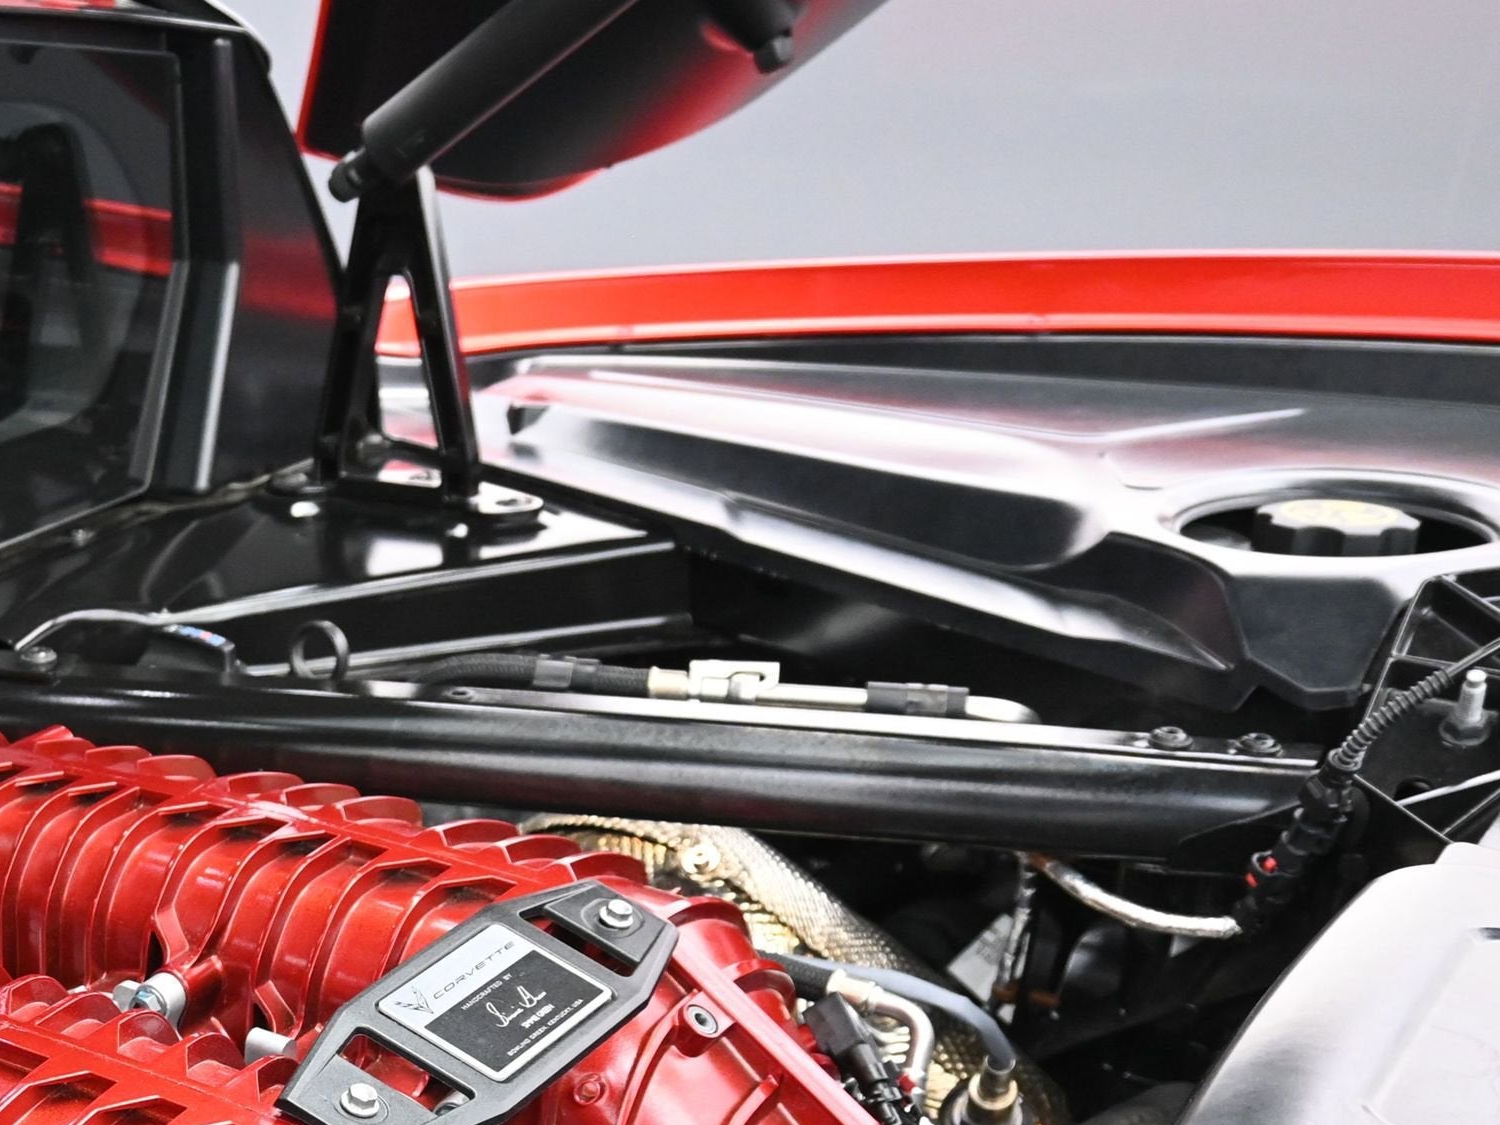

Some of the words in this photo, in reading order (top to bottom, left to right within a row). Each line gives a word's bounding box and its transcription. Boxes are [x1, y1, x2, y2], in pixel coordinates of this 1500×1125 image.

[433, 940, 515, 1000] CORVETTE
[461, 980, 503, 1010] HANDCRAFTED
[502, 972, 513, 981] BY
